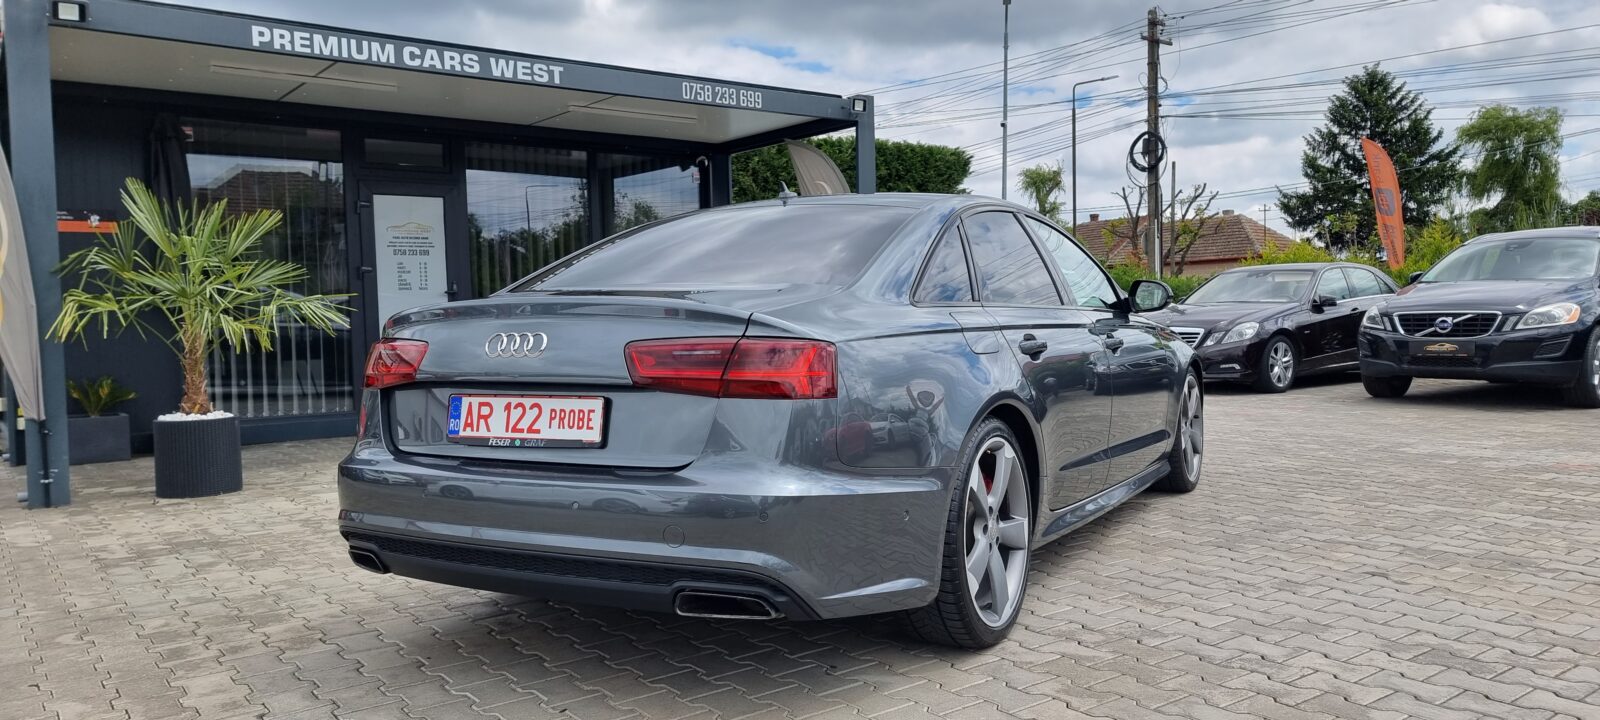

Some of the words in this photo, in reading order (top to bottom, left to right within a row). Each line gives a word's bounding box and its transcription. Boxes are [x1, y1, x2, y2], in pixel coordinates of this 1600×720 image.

[251, 25, 395, 64] PREMIUM
[402, 46, 480, 73] CARS
[489, 57, 564, 84] WEST
[682, 82, 712, 102] 0758
[715, 86, 737, 105] 233
[740, 90, 762, 108] 699
[449, 418, 460, 431] RO
[462, 401, 494, 432] AR
[504, 401, 543, 434] 122
[548, 408, 596, 430] PROBE
[488, 437, 511, 447] FESER
[524, 438, 547, 447] GRAF
